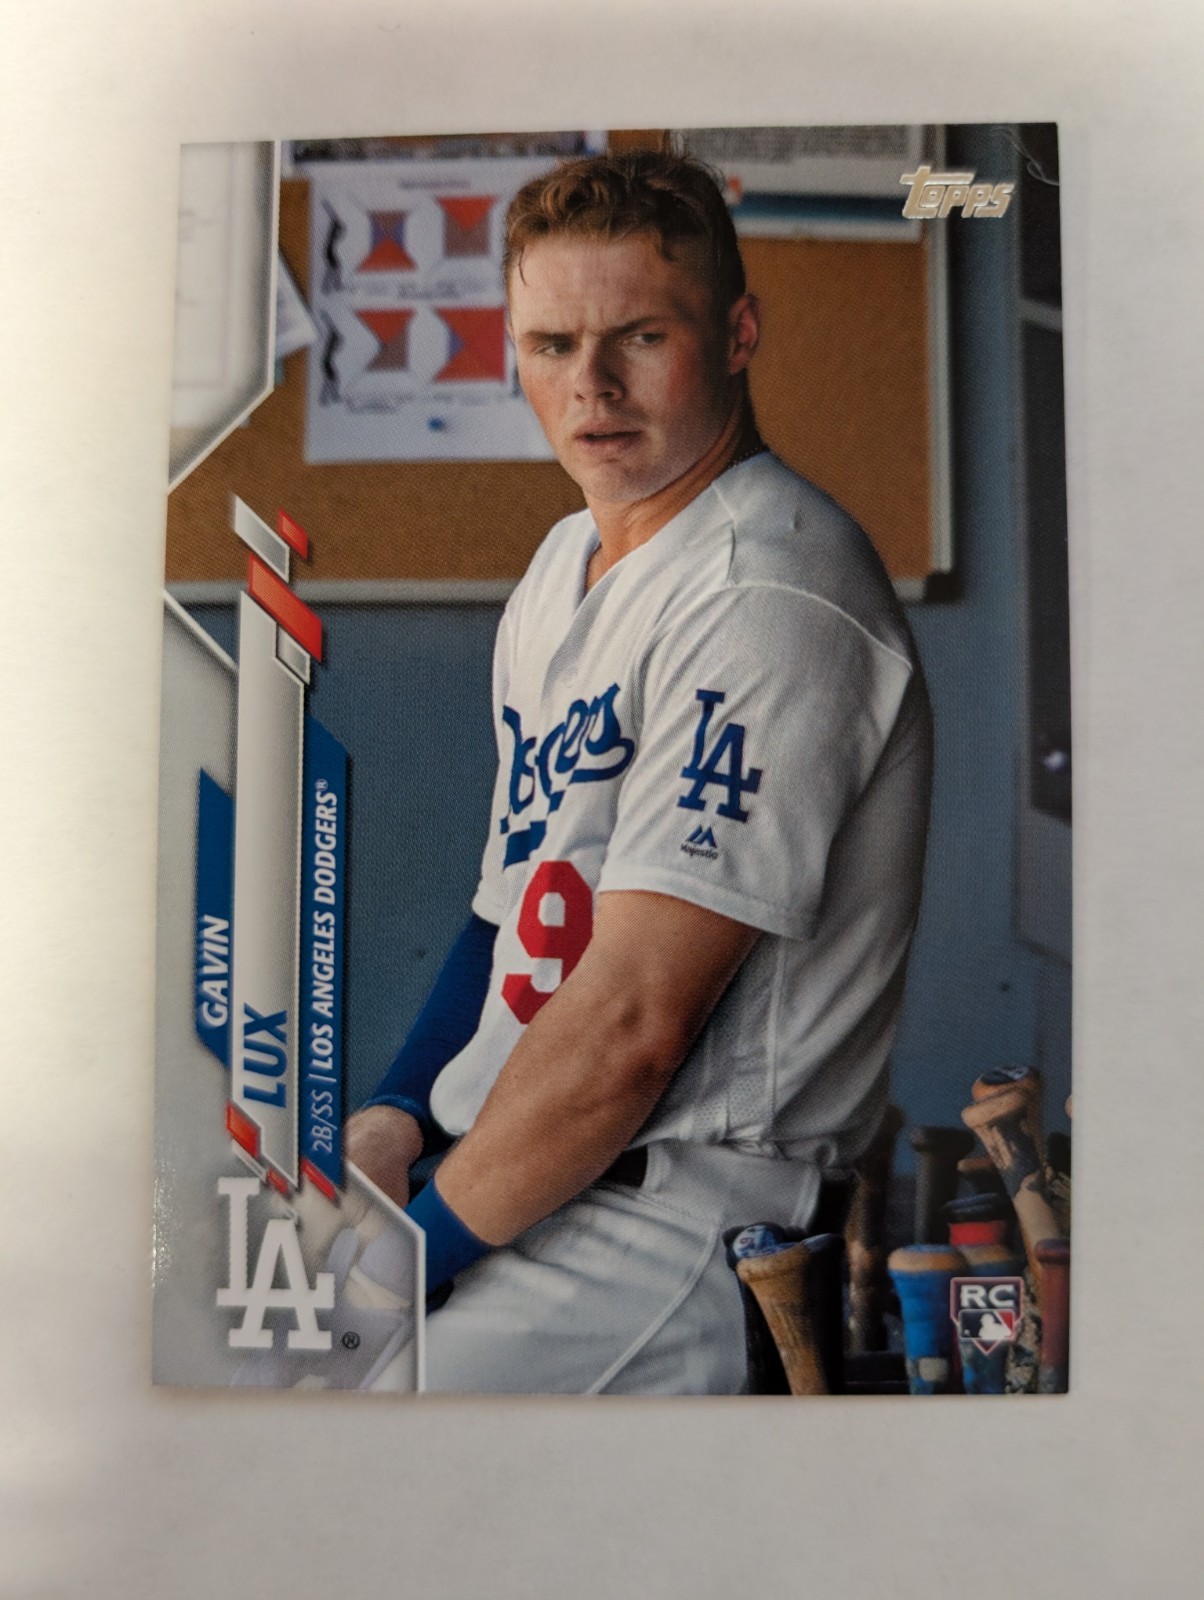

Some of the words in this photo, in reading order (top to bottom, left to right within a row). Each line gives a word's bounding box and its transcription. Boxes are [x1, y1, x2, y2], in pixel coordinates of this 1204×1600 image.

[677, 689, 763, 823] LA
[202, 915, 230, 1028] GAVIN
[312, 911, 336, 1018] ANGELES
[501, 860, 594, 1024] 9
[243, 1003, 288, 1107] LUX
[312, 1022, 335, 1069] LOS
[312, 1089, 337, 1153] 2B/SS
[217, 1177, 335, 1349] LA
[960, 1284, 1015, 1309] RC
